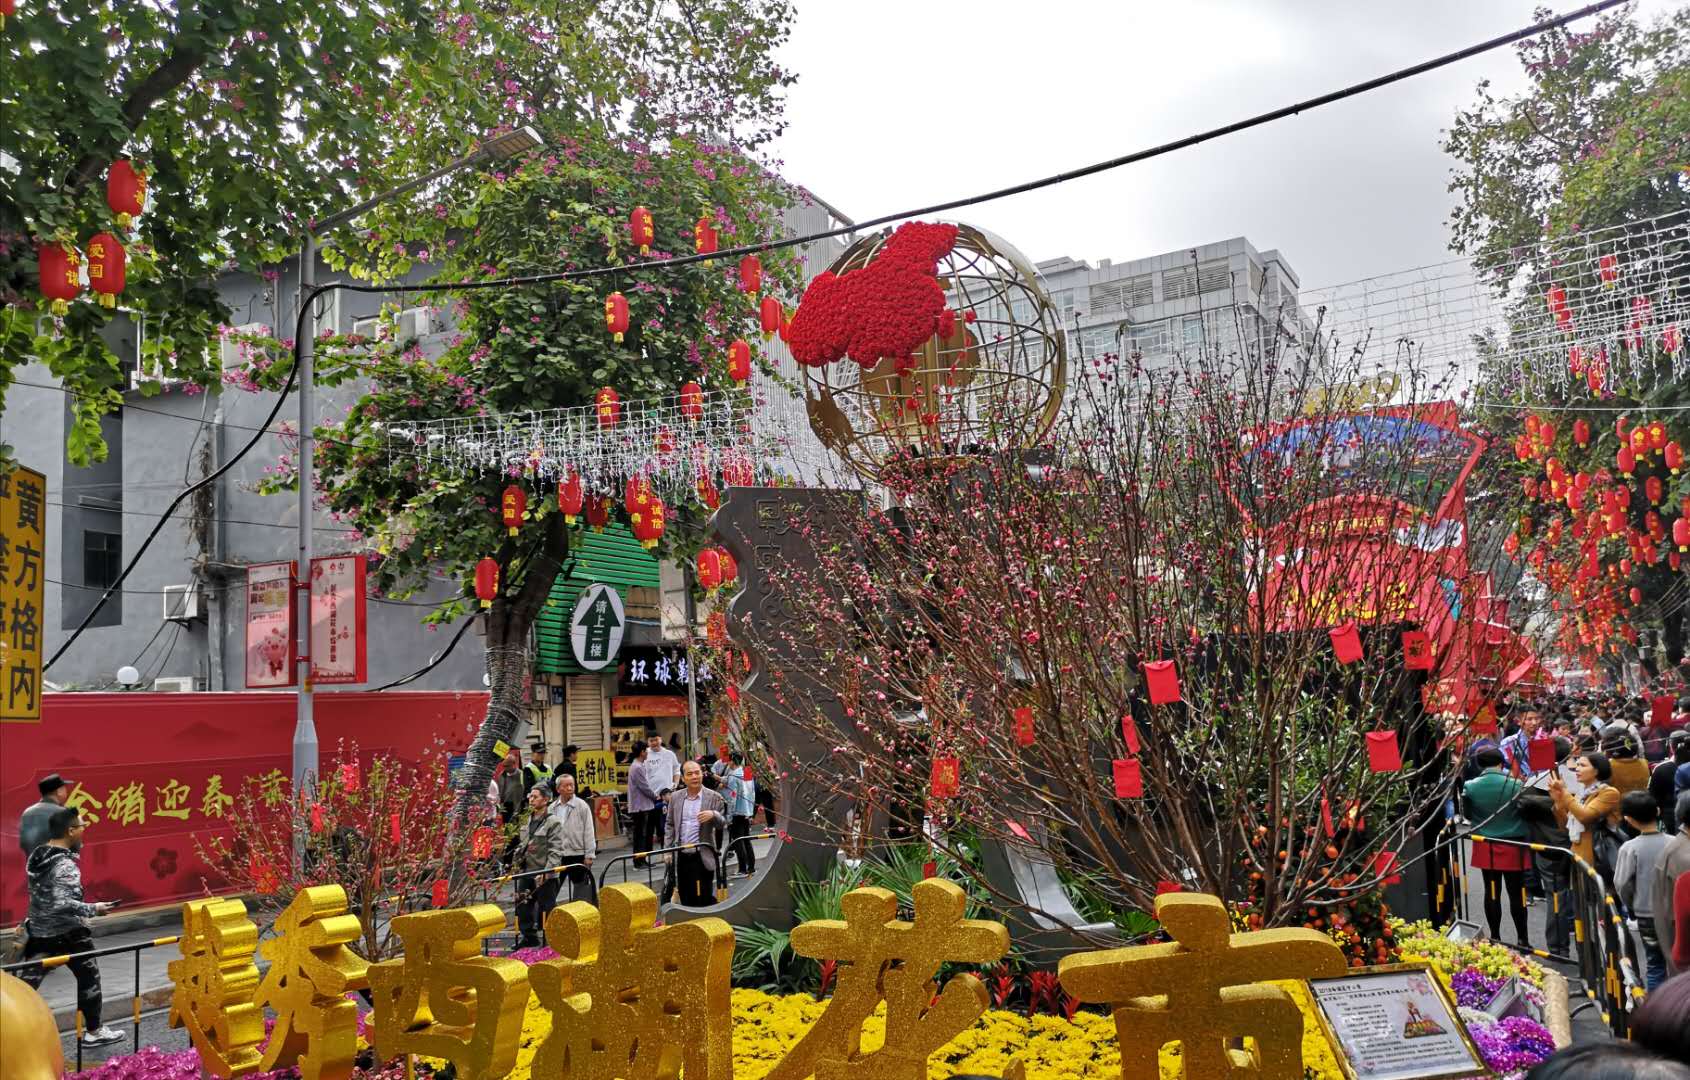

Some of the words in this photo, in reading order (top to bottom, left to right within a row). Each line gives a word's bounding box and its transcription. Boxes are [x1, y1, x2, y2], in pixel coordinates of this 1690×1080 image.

[9, 479, 41, 711] 黄方格内
[590, 600, 607, 657] 请上二楼
